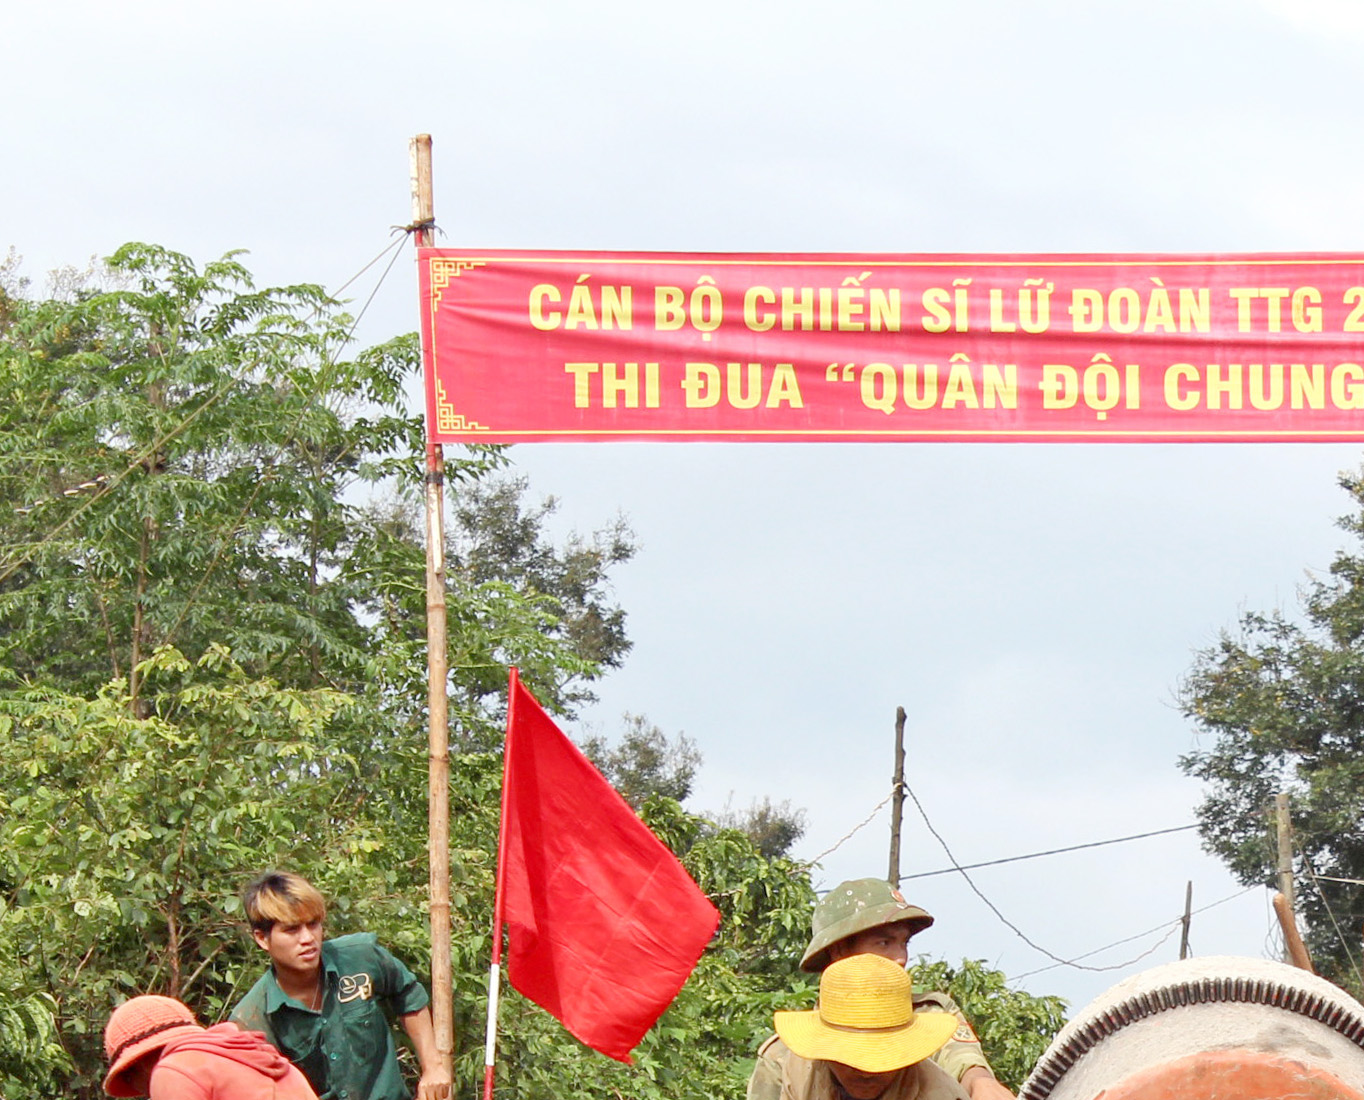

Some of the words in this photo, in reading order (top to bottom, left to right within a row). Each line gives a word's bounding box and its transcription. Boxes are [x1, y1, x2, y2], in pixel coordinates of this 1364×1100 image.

[529, 274, 633, 330] CÁN
[655, 276, 724, 340] BỘ
[744, 272, 901, 331] CHIẾN
[923, 279, 971, 333] SĨ
[991, 279, 1054, 334] LỮ
[1069, 278, 1210, 333] ĐOÀN
[1230, 287, 1323, 332] TTG
[565, 363, 660, 408] THI
[681, 363, 804, 408] ĐUA
[1040, 354, 1140, 420] ĐỘI
